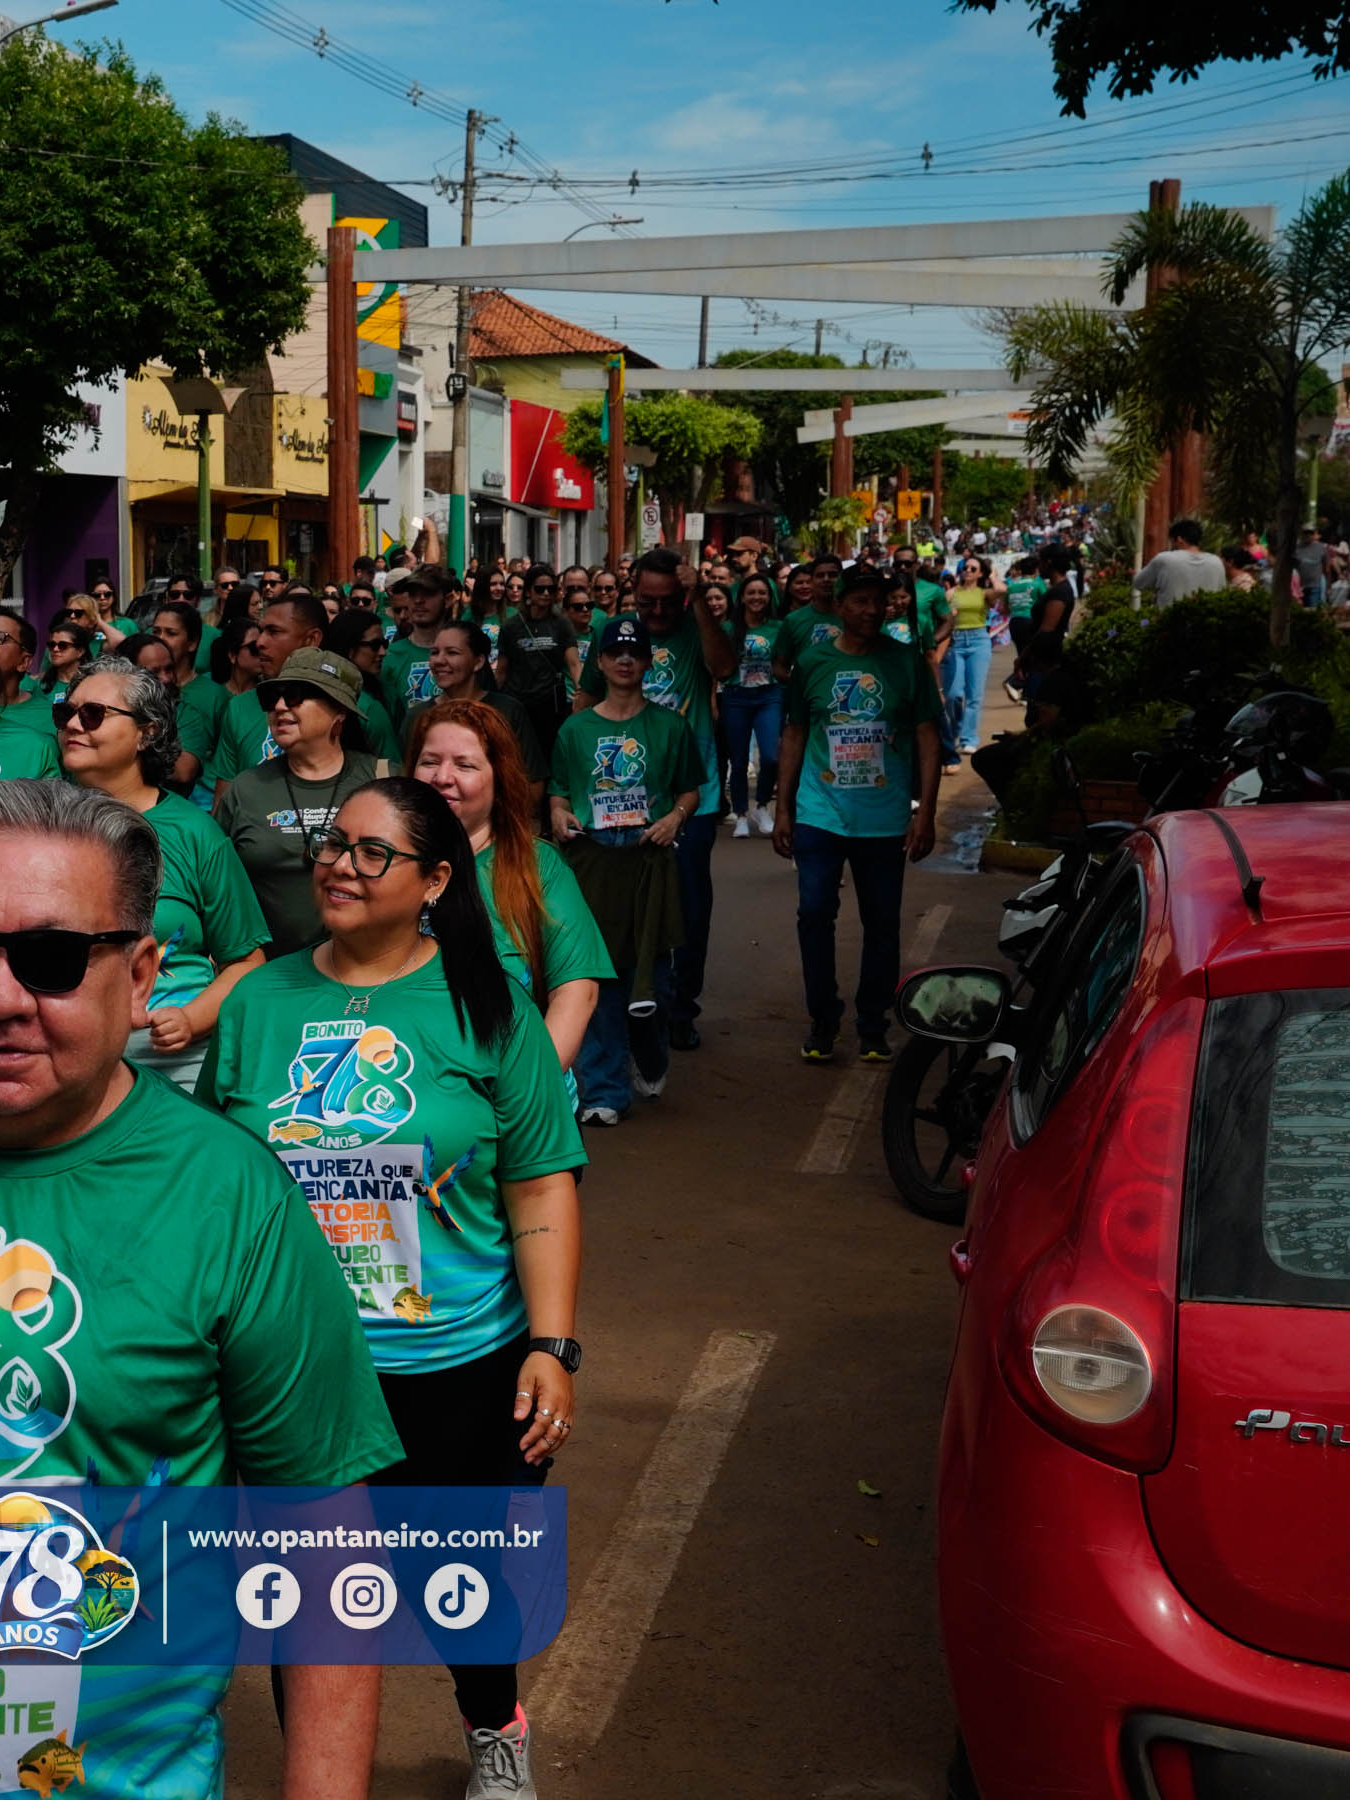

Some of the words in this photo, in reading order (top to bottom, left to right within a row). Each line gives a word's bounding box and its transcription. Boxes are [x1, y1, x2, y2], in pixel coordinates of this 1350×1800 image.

[305, 1022, 364, 1039] BONITO
[290, 1027, 416, 1128] 78
[315, 1133, 363, 1149] ANOS
[284, 1158, 375, 1179] TUREZA
[381, 1164, 414, 1181] QUE
[322, 1222, 402, 1244] NSPIRA.
[343, 1264, 410, 1285] GENTE
